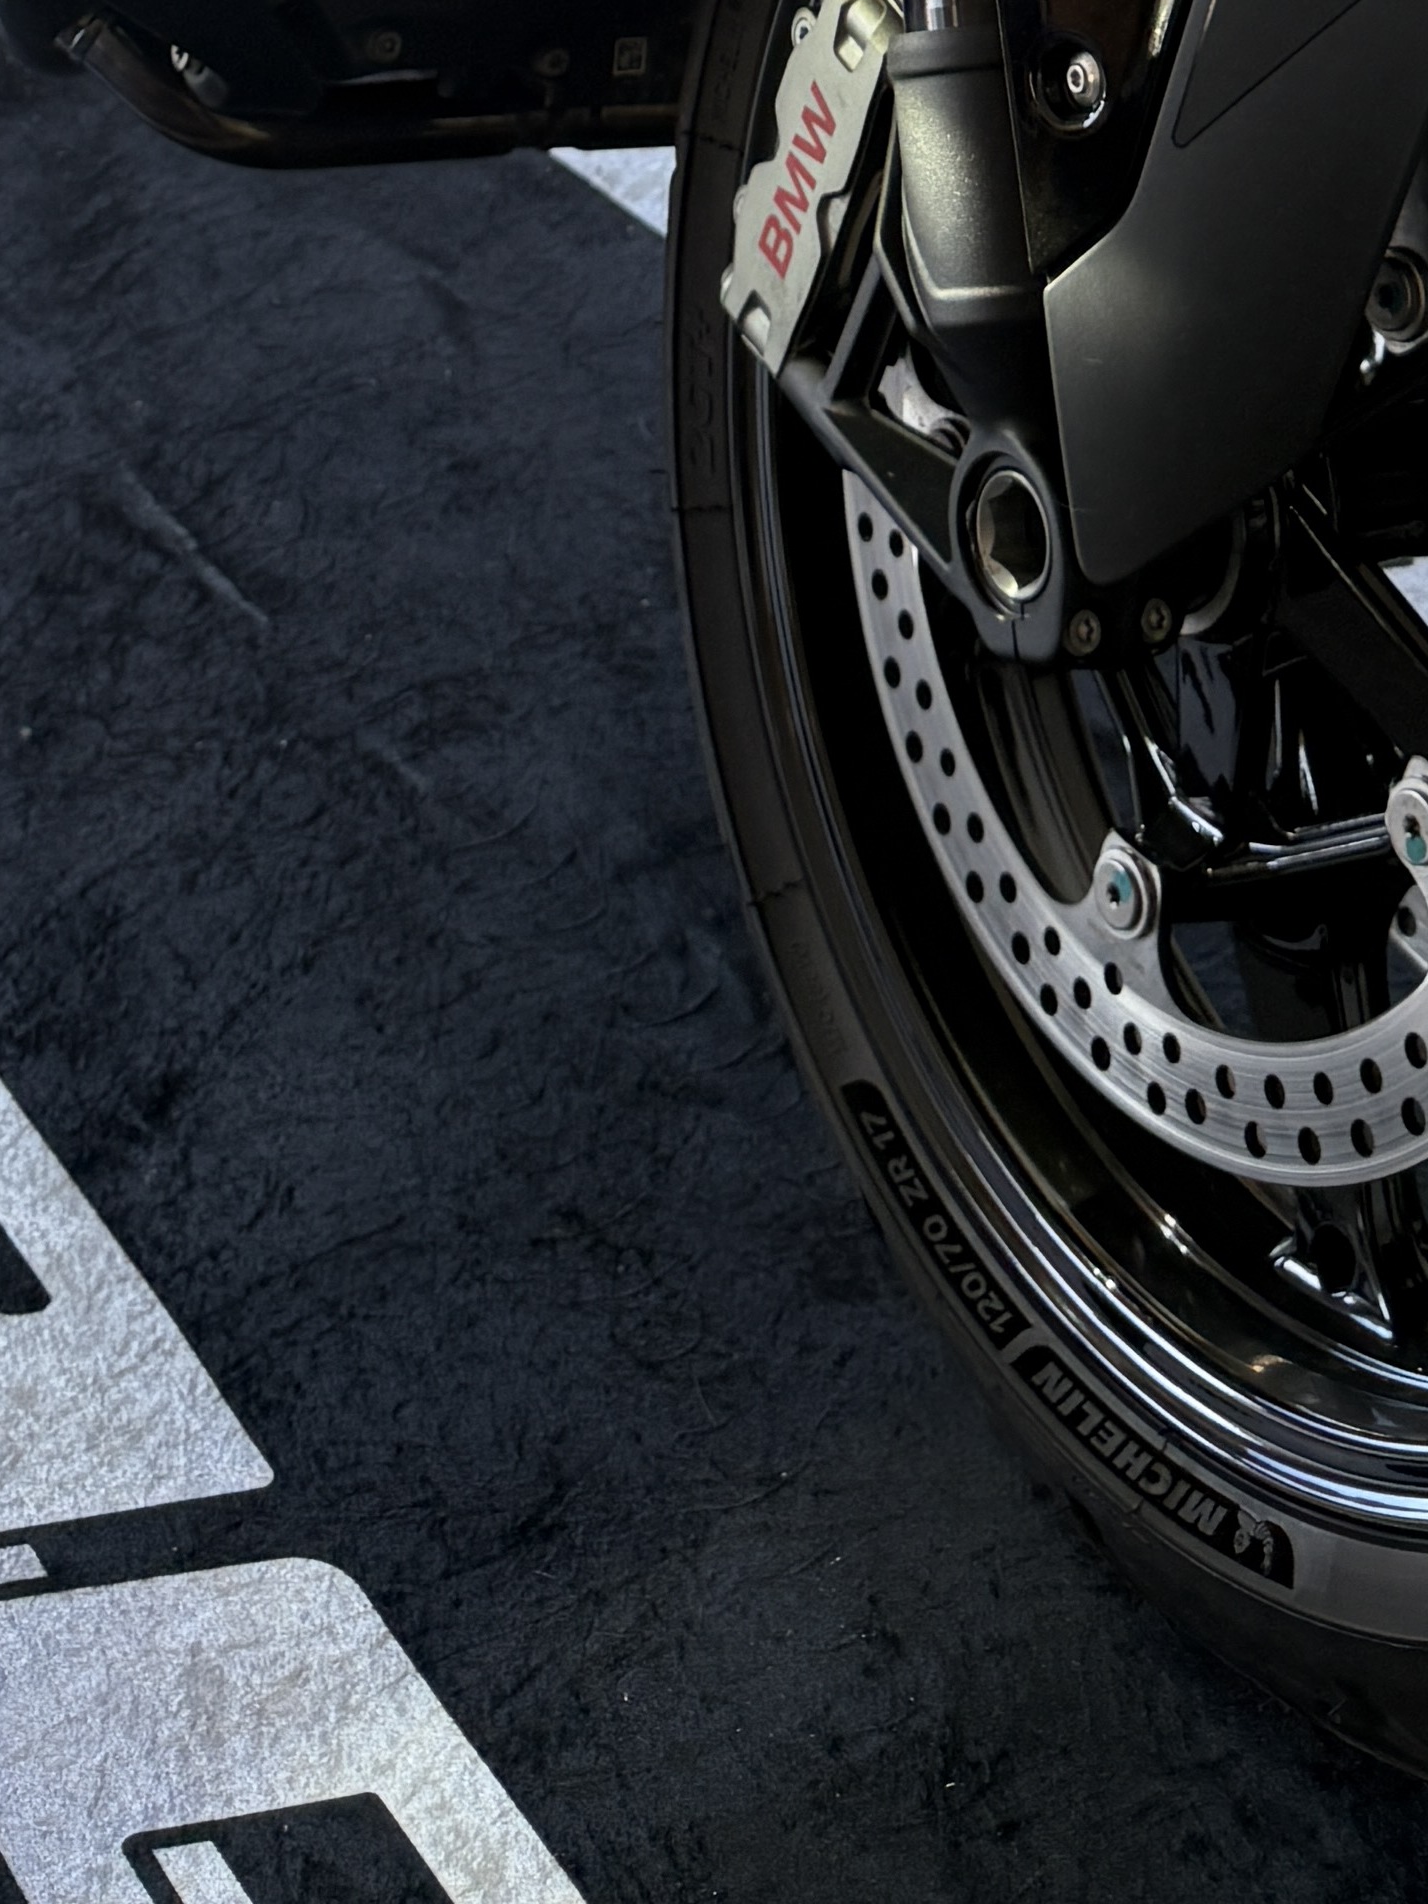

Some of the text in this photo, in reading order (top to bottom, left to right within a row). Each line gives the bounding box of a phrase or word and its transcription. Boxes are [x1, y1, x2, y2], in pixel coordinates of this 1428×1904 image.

[757, 80, 840, 279] BMW
[856, 1110, 1012, 1334] 120/70 ZR 17
[1031, 1359, 1229, 1536] MICHELIN
